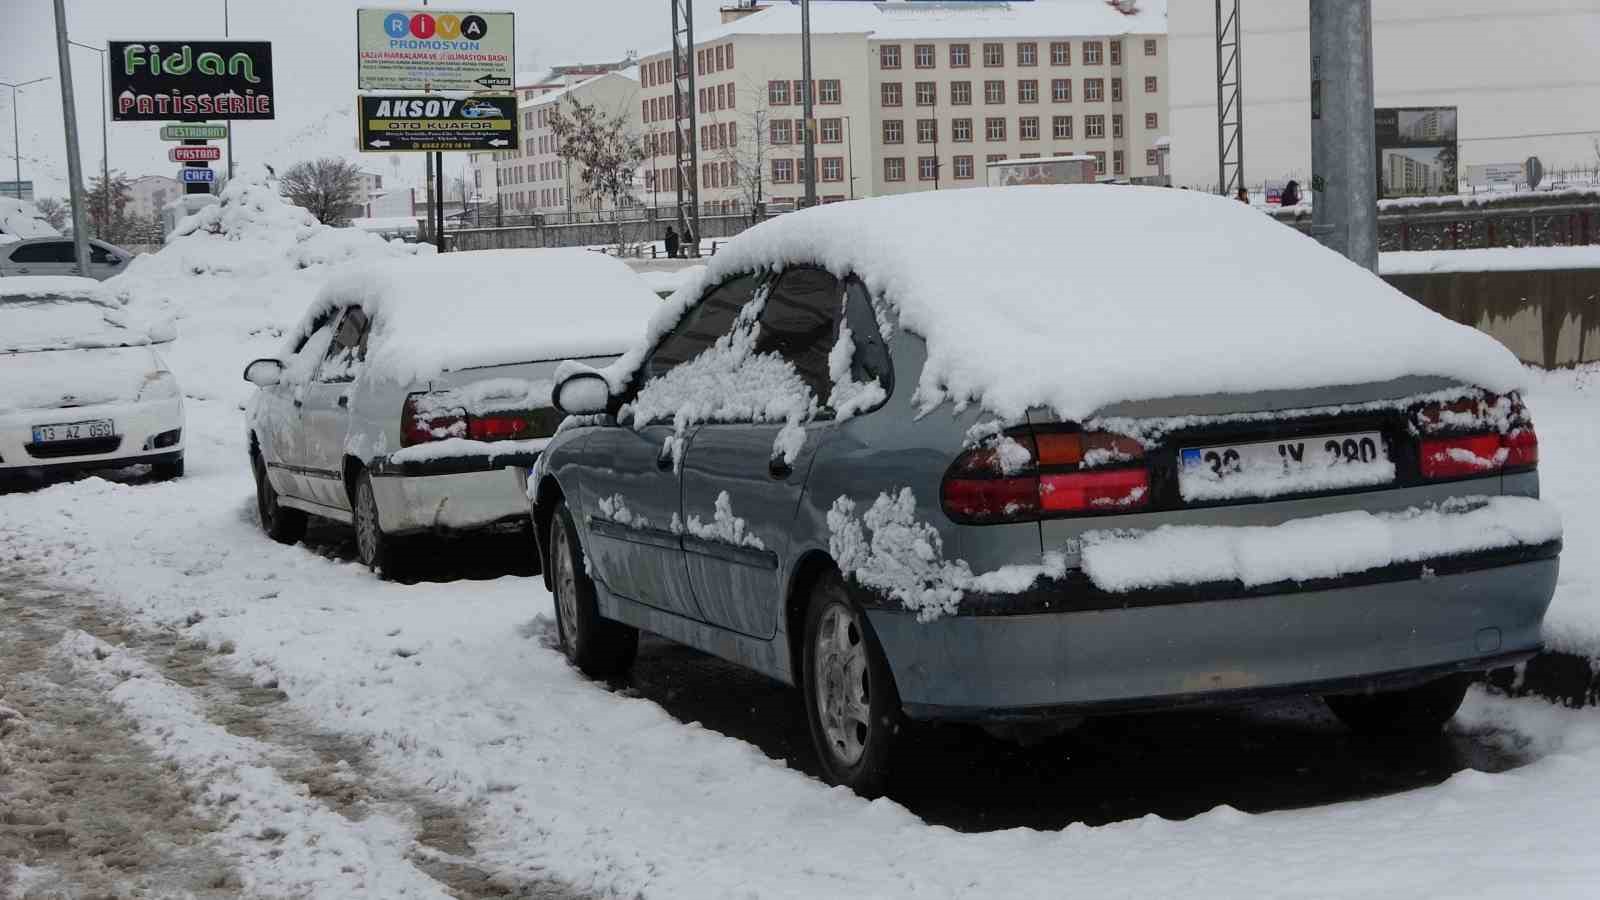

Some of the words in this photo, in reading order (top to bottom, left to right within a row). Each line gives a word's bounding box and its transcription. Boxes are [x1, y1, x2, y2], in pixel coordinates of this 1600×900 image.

[389, 40, 480, 51] PROMOSYON
[376, 100, 456, 118] AKSOY
[166, 127, 226, 138] RESTAURANT
[175, 148, 220, 159] PASTANE
[185, 170, 212, 181] CAFE
[42, 427, 56, 440] 13
[66, 426, 80, 439] AZ
